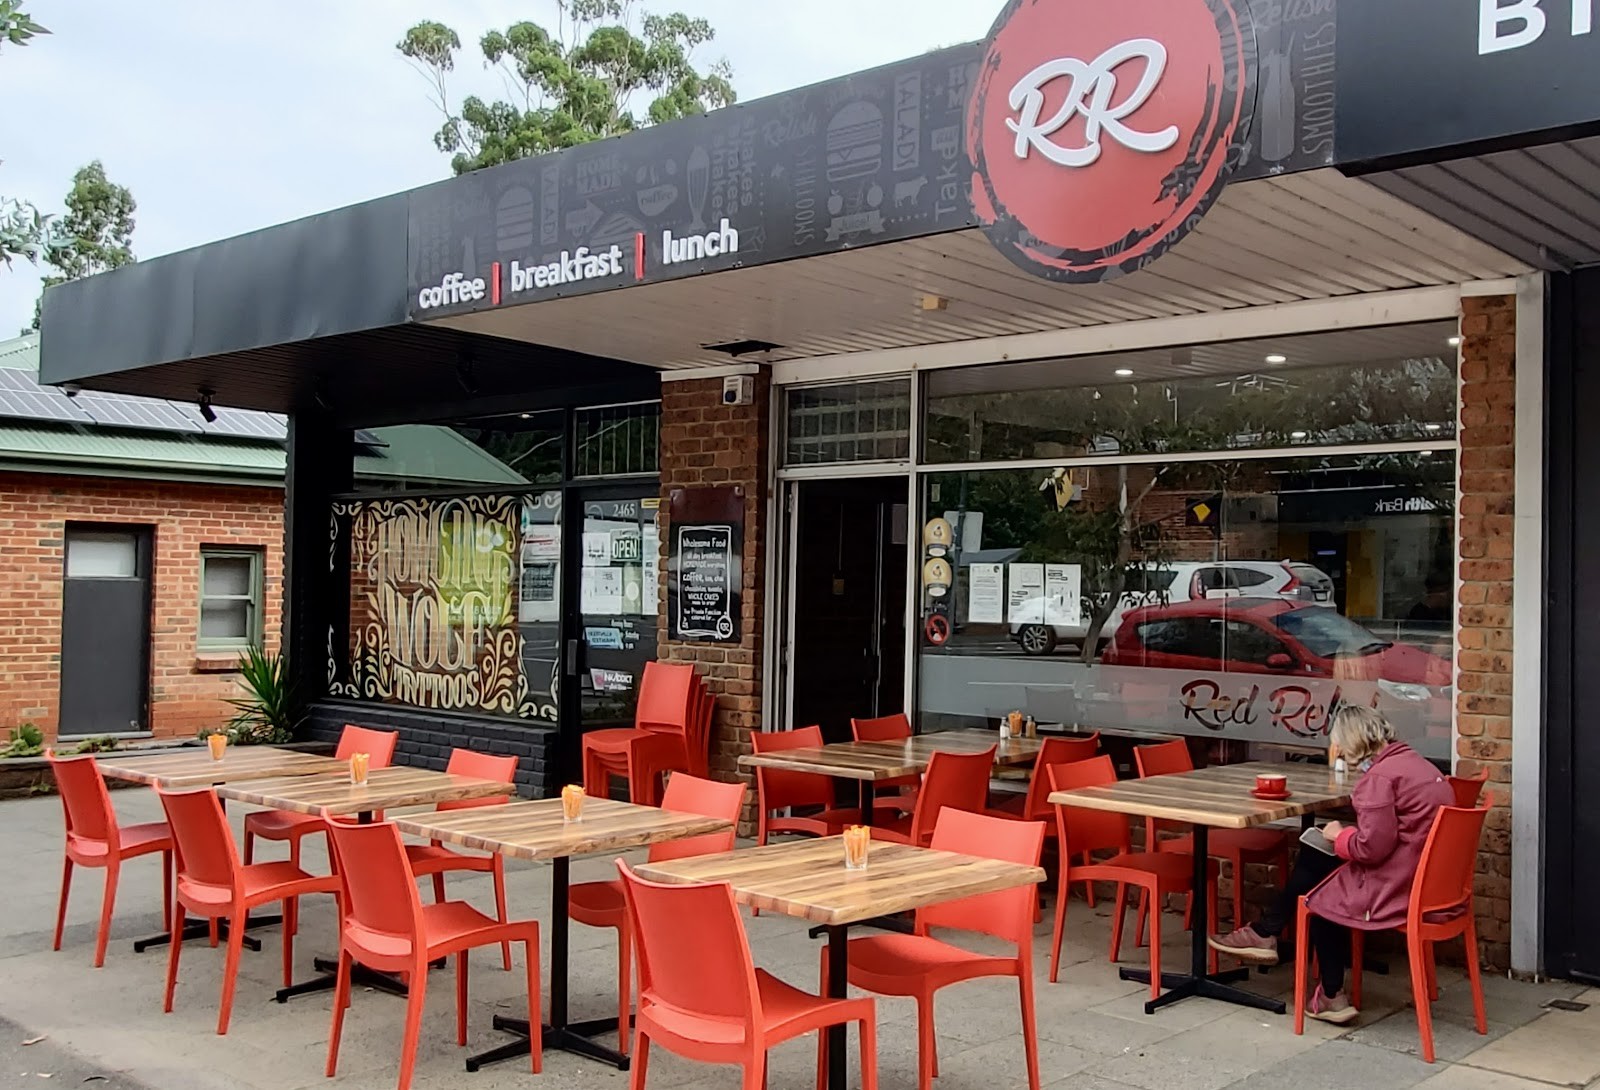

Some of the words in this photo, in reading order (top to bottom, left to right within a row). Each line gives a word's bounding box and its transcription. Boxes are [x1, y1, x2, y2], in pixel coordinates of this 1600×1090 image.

[1302, 22, 1336, 154] SMOOTHIES
[794, 144, 817, 246] SMOOTHIES
[419, 273, 486, 309] coffee
[511, 245, 623, 292] breakfast
[663, 217, 739, 265] lunch
[612, 503, 635, 517] 2465
[613, 540, 637, 558] OPEN
[712, 537, 726, 548] Food
[394, 664, 480, 709] TATTOOS
[1179, 678, 1260, 731] Red
